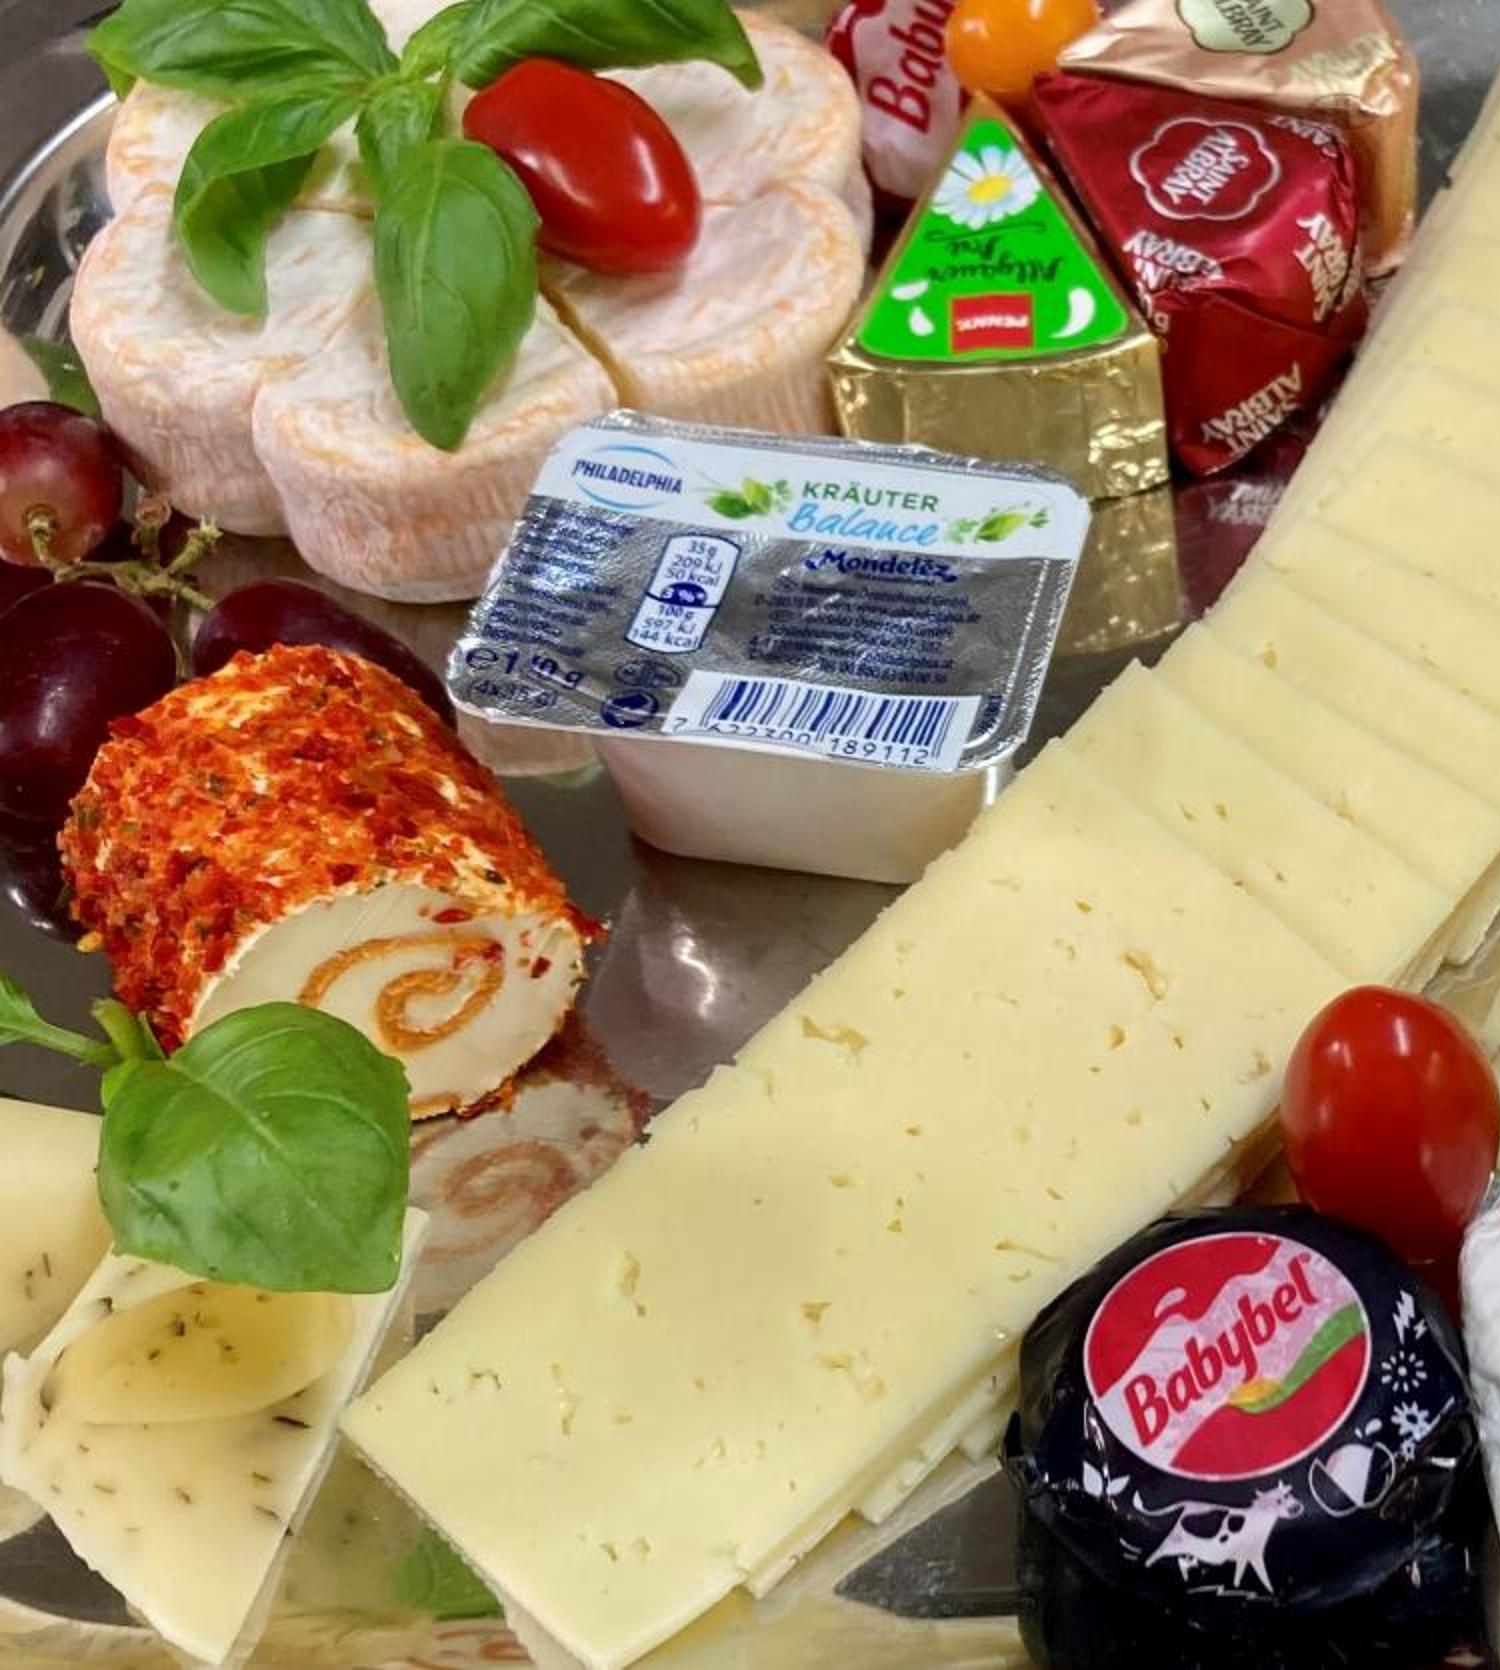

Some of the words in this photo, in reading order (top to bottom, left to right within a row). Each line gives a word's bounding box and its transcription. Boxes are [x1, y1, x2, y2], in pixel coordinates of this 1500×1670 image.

[1201, 360, 1302, 444] ALBRAY
[571, 458, 683, 496] PHILADELPHIA
[801, 480, 940, 513] KRÄUTER
[785, 501, 940, 547] Balance
[688, 570, 721, 588] kcal
[642, 617, 675, 631] 597
[664, 631, 700, 649] kcal
[829, 736, 930, 766] 189112
[1123, 1251, 1325, 1449] Babybel
